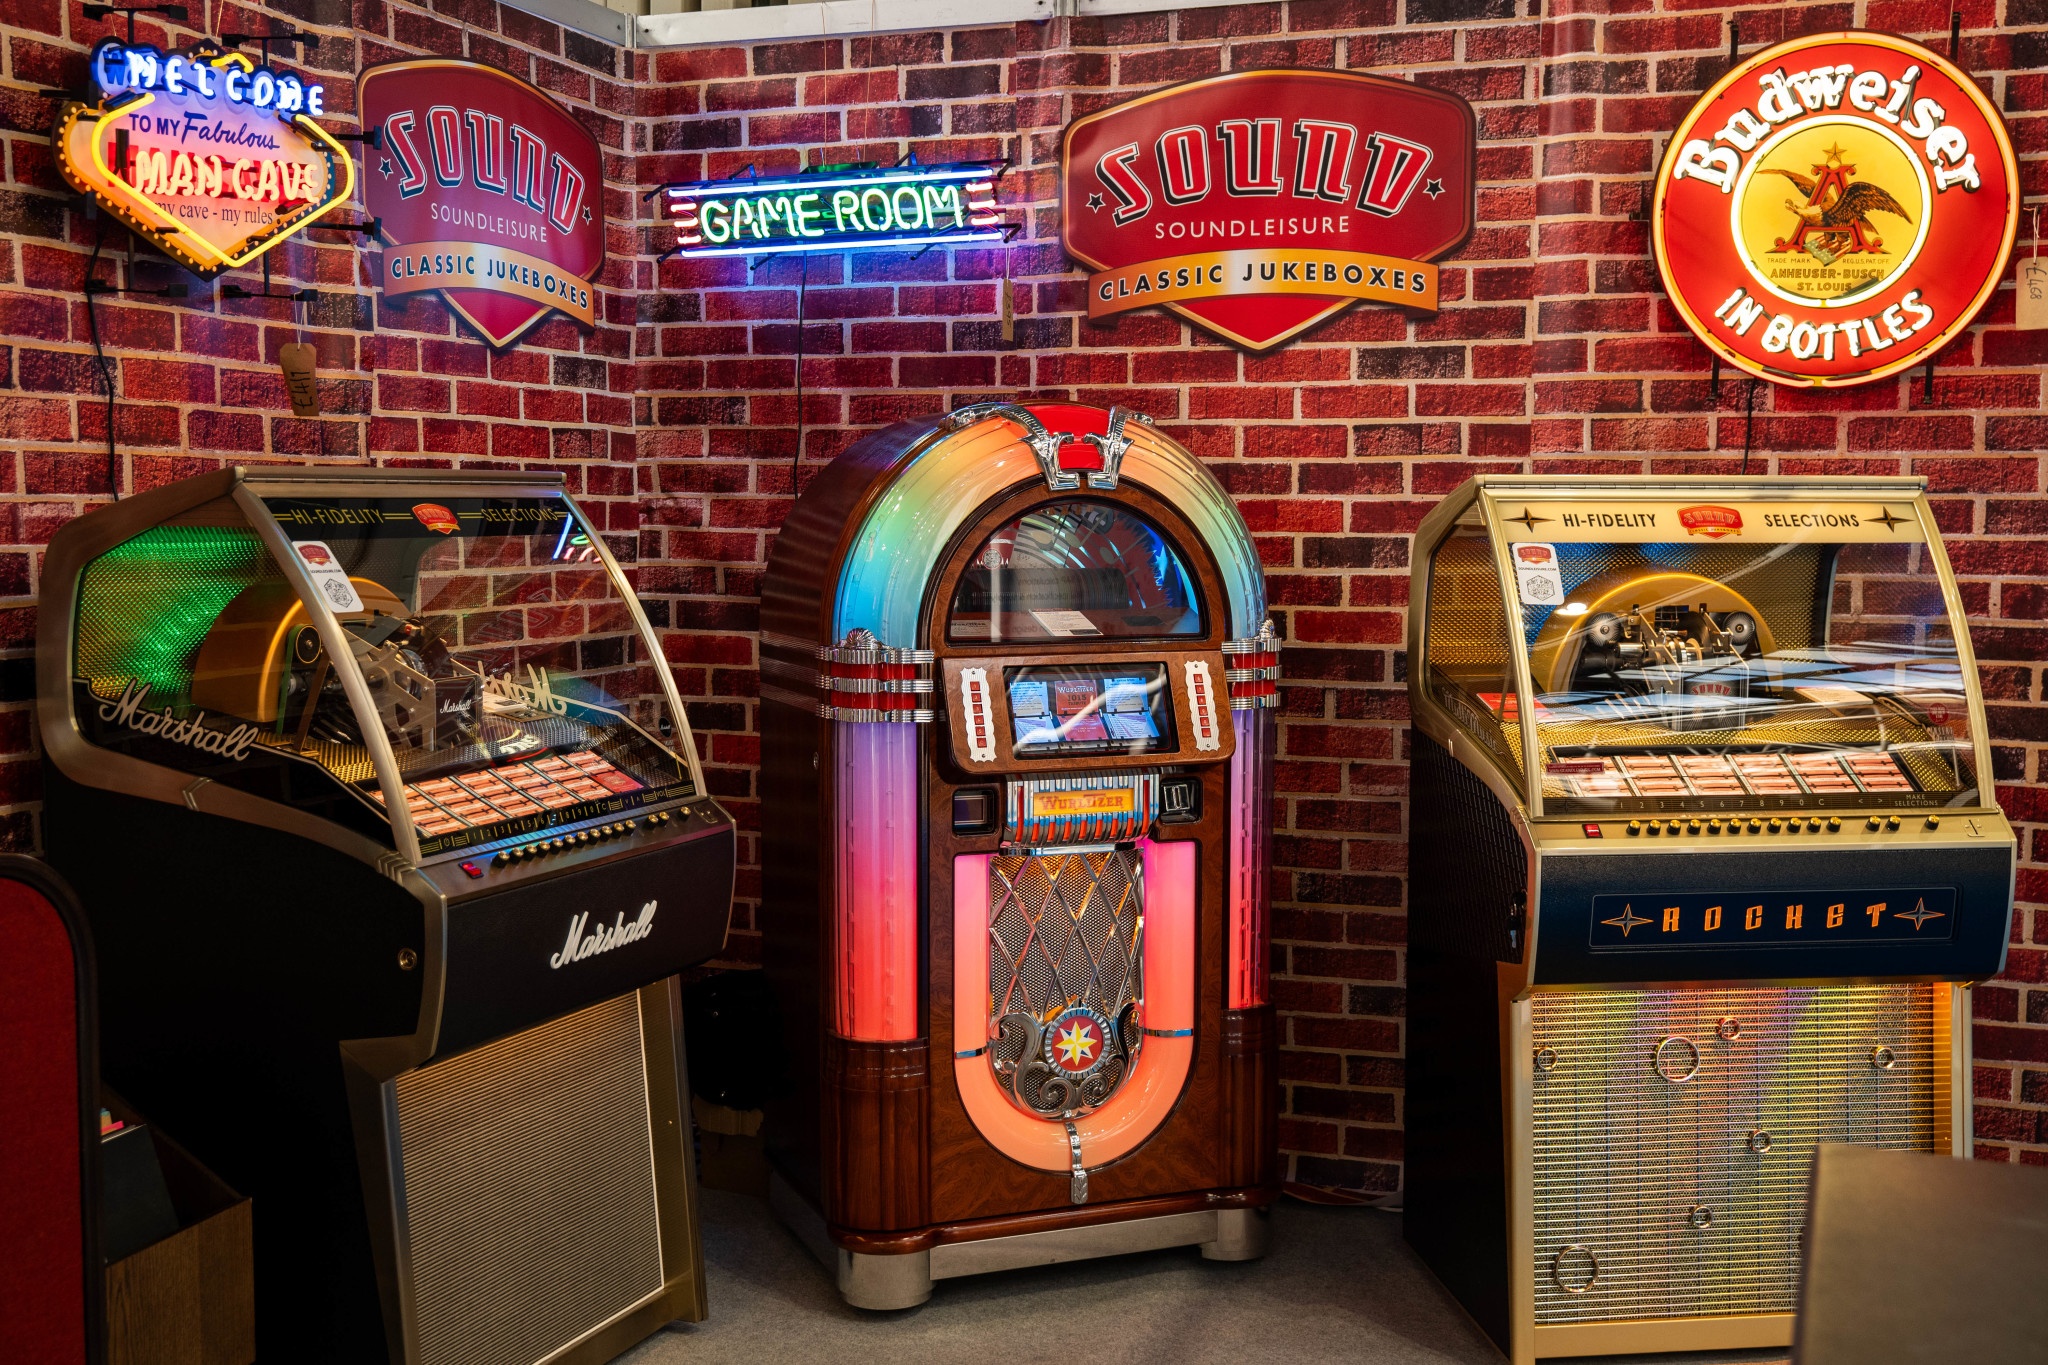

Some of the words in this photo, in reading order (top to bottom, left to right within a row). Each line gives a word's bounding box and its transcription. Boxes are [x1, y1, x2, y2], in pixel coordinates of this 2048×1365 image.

[123, 50, 324, 116] WELCOME
[129, 113, 151, 133] TO
[157, 118, 180, 137] MY
[182, 111, 280, 150] Fabulous
[1673, 63, 1982, 196] Budweiser
[132, 149, 223, 197] MAN
[232, 157, 320, 204] CAVE
[384, 105, 585, 235] SOUND
[1095, 117, 1434, 227] SOUND
[179, 201, 209, 220] cave
[221, 205, 241, 226] my
[244, 207, 274, 224] rules
[430, 202, 548, 243] SOUNDLEISURE
[700, 193, 825, 243] GAME
[832, 184, 964, 232] ROOM
[1155, 215, 1350, 239] SOUNDLEISURE
[391, 254, 476, 280] CLASSIC
[486, 261, 589, 310] JUKEBOXES
[1099, 264, 1224, 301] CLASSIC
[1241, 261, 1428, 294] JUKEBOXES
[1770, 268, 1885, 280] ANHEUSER-BUSCH
[1797, 282, 1814, 292] ST.
[1817, 282, 1852, 292] LOUIS
[2025, 265, 2048, 300] £468
[1714, 287, 1764, 337] IN
[1760, 287, 1935, 361] BOTTLES
[290, 508, 384, 524] HI-FIDELITY
[481, 508, 558, 522] SELECTIONS
[1562, 513, 1656, 528] HI-FIDELITY
[1764, 514, 1860, 528] SELECTIONS
[100, 678, 259, 762] Marshall
[439, 698, 472, 714] Marshall
[551, 900, 659, 969] Marshall
[1662, 902, 1887, 932] ROCKET
